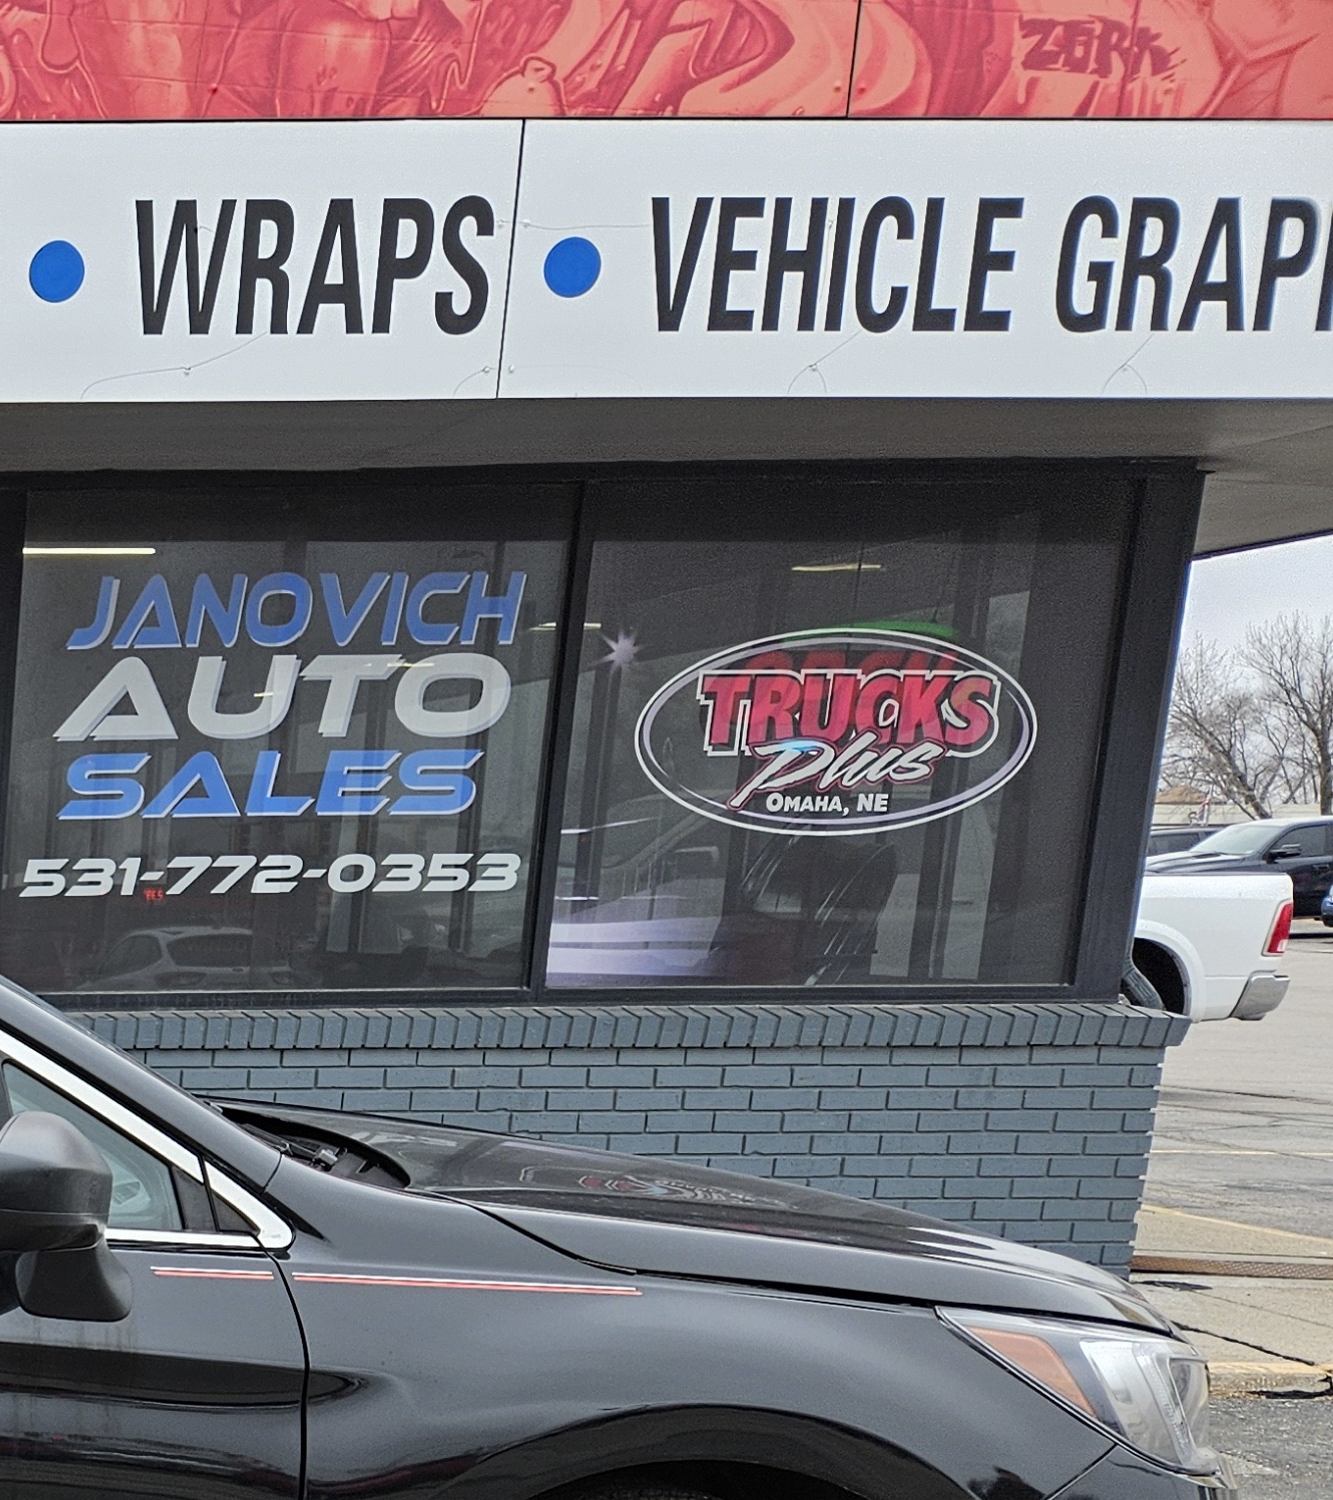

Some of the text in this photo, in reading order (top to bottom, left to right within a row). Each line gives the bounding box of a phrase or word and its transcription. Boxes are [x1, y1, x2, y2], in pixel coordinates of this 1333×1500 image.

[135, 195, 495, 336] WRAPS
[651, 196, 1024, 334] VEHICLE
[66, 571, 527, 651] JANOVICH
[52, 652, 513, 742] AUTO
[698, 671, 1001, 757] TRUCKS
[57, 748, 485, 820] SALES
[729, 731, 945, 809] Plus
[765, 792, 890, 817] OMAHA, NE
[18, 852, 522, 898] 531-772-0353
